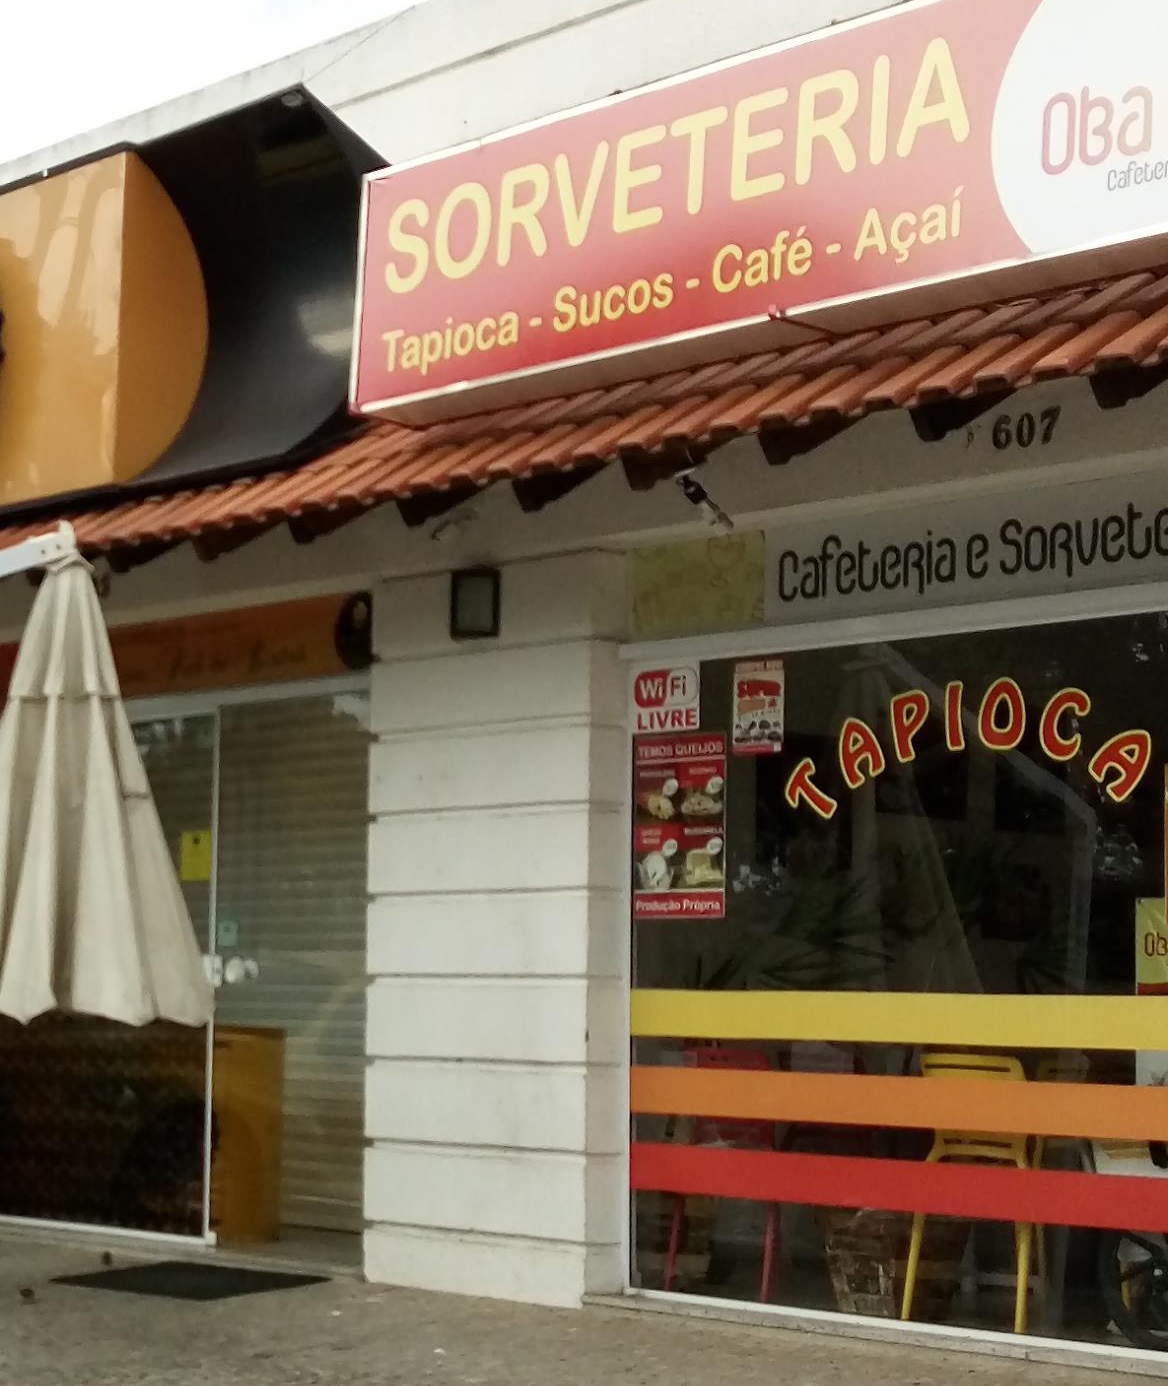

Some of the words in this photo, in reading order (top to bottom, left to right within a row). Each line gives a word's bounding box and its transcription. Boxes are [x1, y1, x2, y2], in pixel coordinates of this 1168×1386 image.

[384, 36, 970, 294] SORVETERIA
[1041, 85, 1153, 175] Oba
[382, 309, 519, 376] Tapioca
[553, 269, 674, 334] Sucos
[712, 225, 814, 294] Café
[854, 186, 965, 264] Açaí
[992, 405, 1062, 450] 607
[966, 533, 989, 579] e
[638, 709, 697, 731] LIVRE
[784, 676, 1153, 819] TAPIOCA
